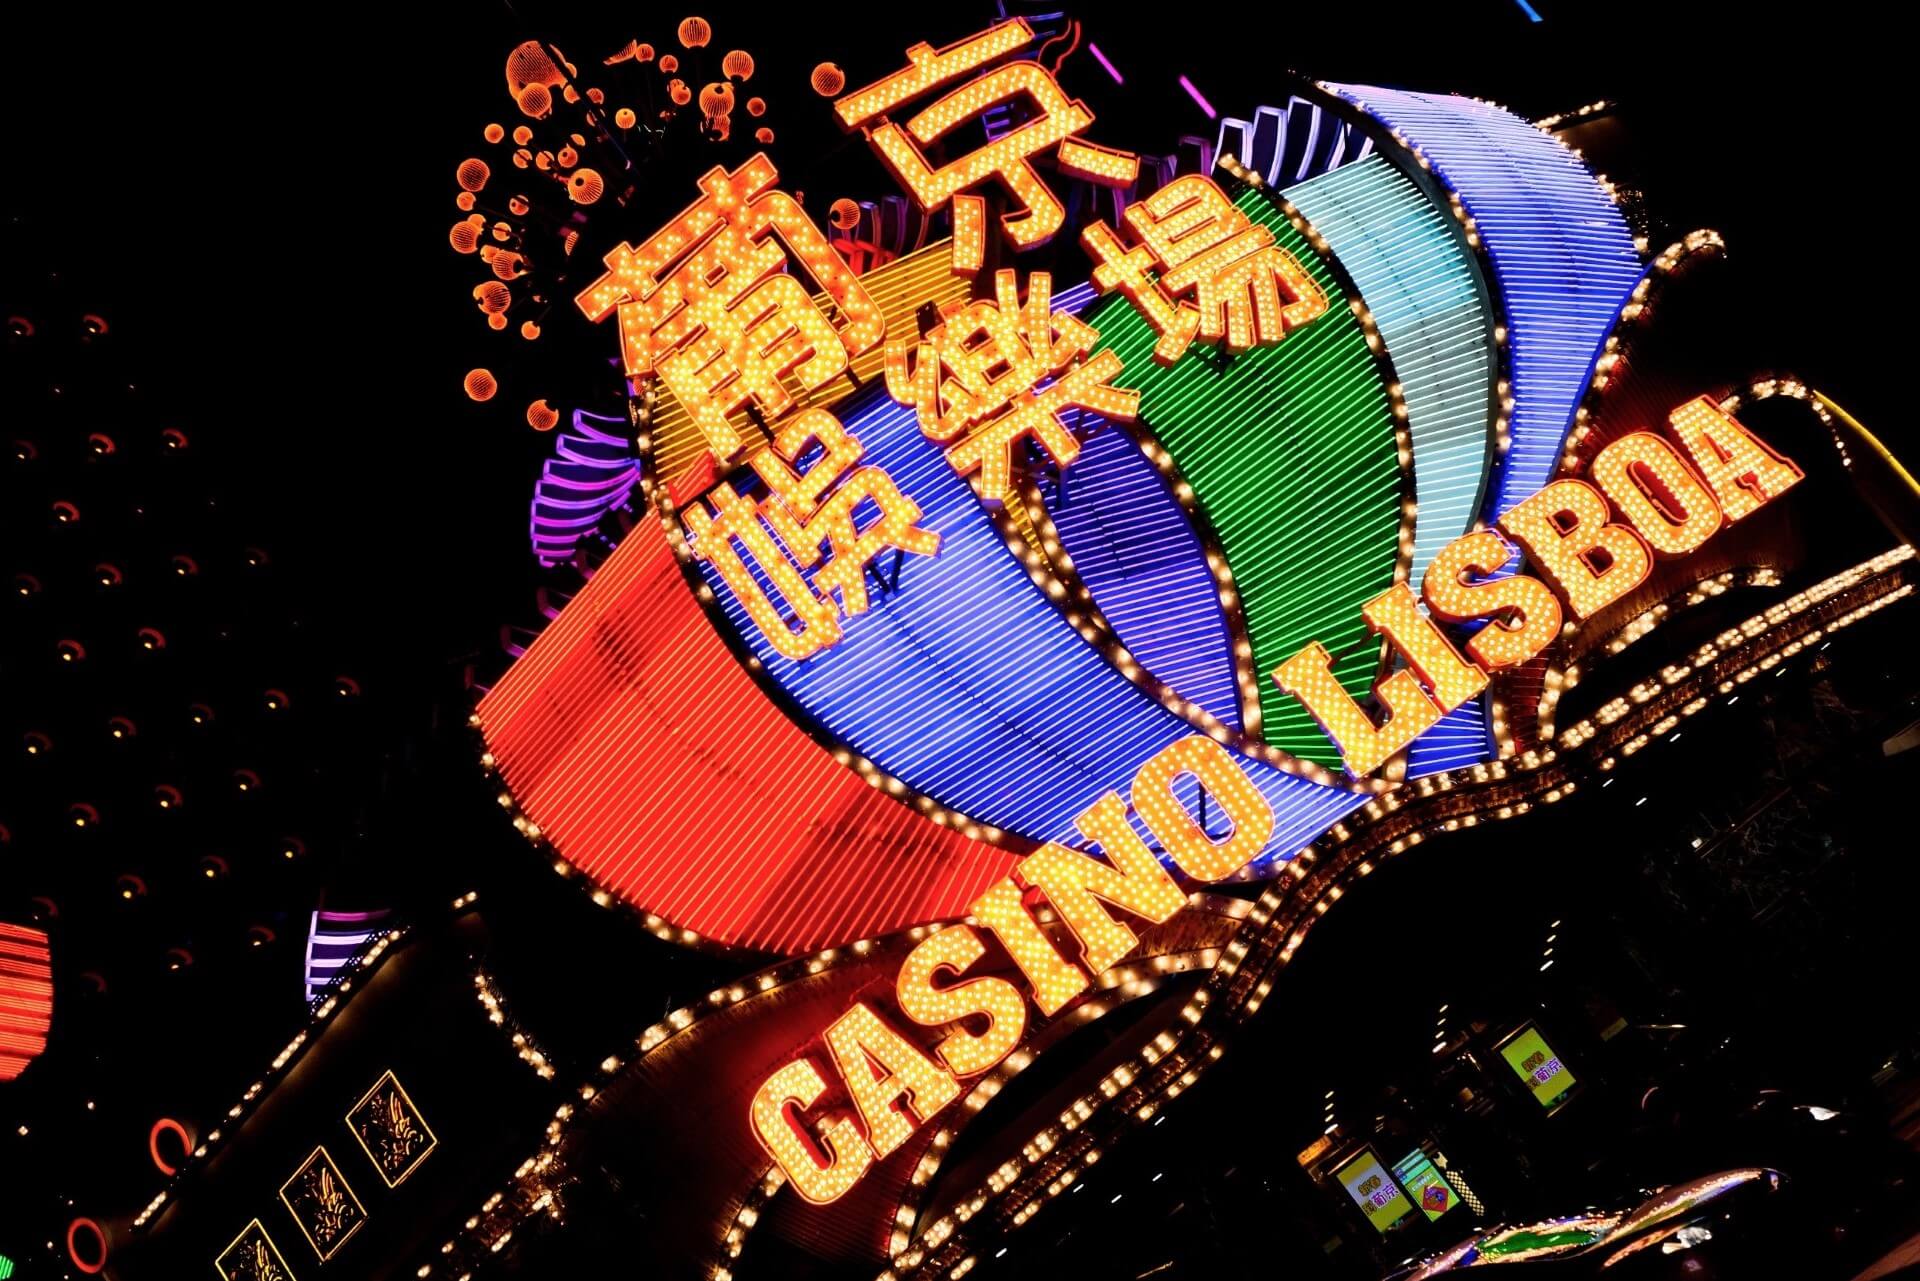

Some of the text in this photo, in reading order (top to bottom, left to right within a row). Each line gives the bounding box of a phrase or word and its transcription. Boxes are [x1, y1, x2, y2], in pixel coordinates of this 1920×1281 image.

[575, 17, 1140, 466] 葡京
[748, 394, 1806, 1205] CASINO LISBOA
